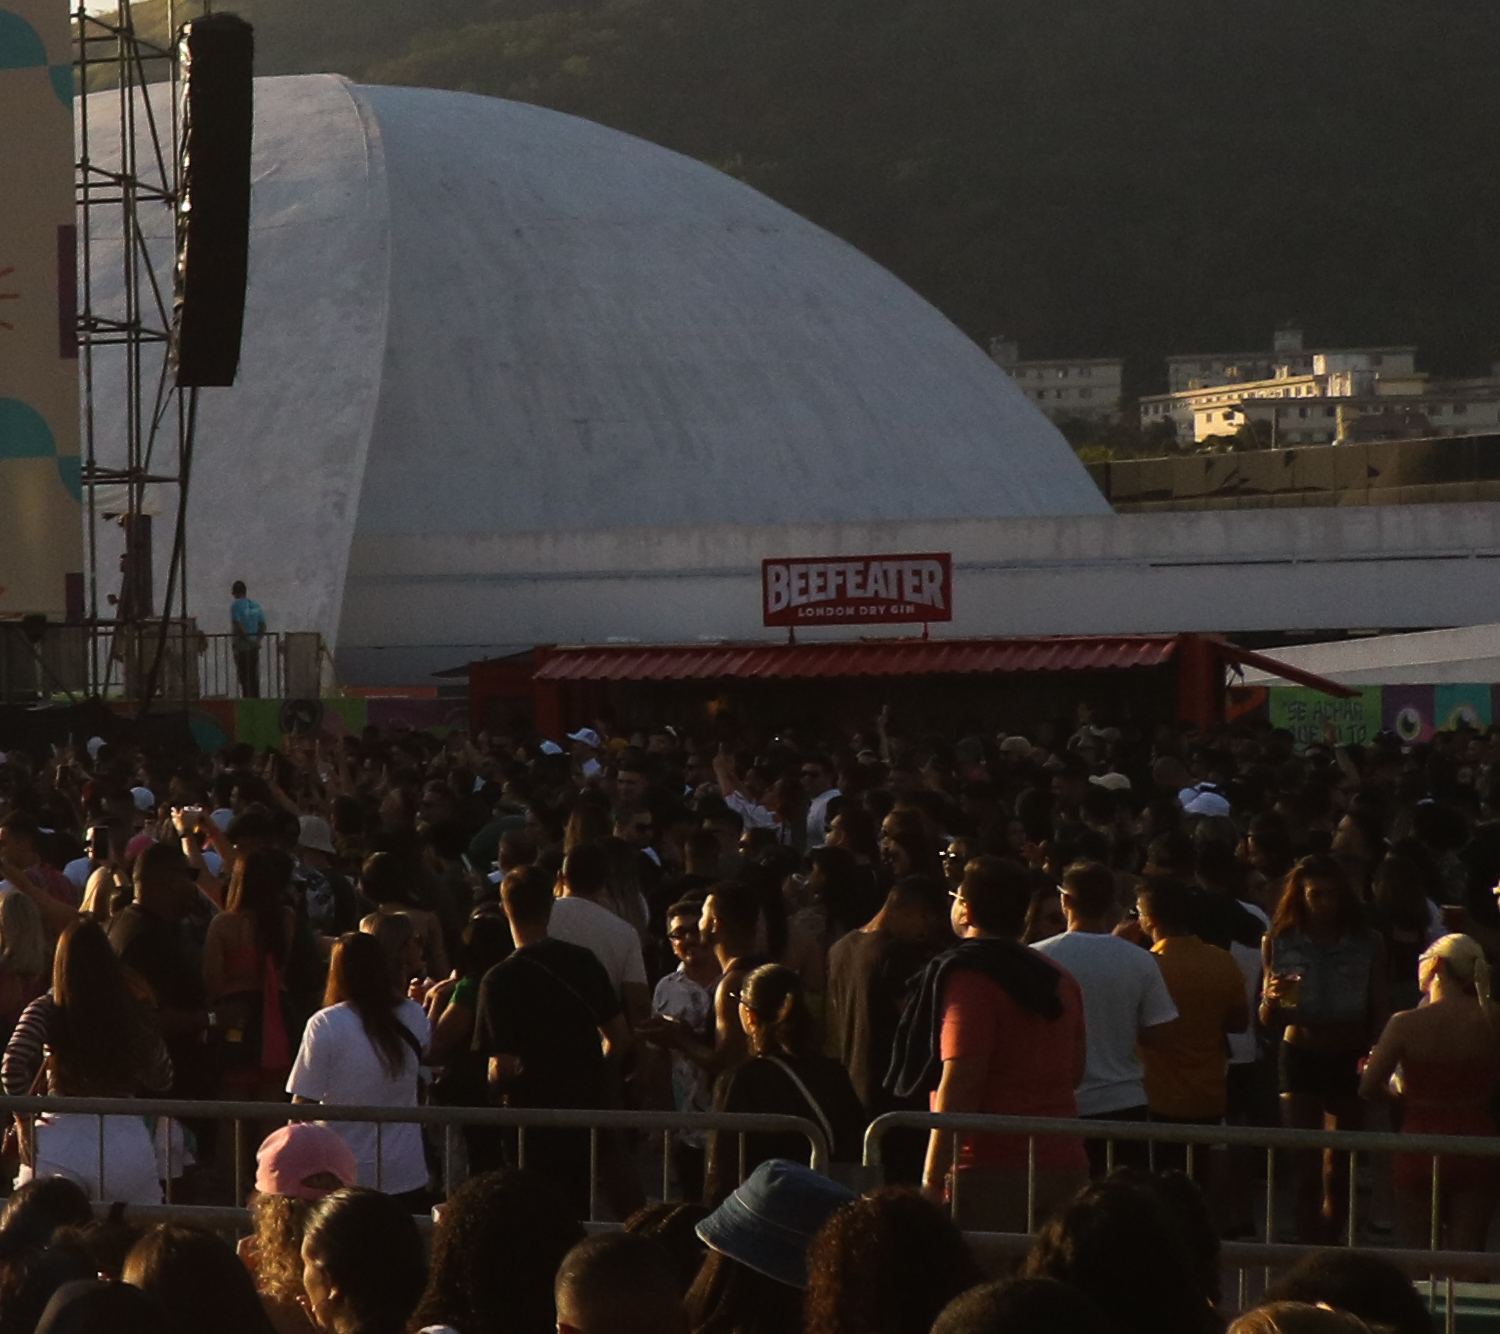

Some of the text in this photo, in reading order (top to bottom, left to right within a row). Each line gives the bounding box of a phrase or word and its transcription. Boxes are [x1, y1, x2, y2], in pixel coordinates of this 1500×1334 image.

[767, 560, 945, 614] BEEFEATER
[798, 604, 915, 617] LONDON DRY GIN
